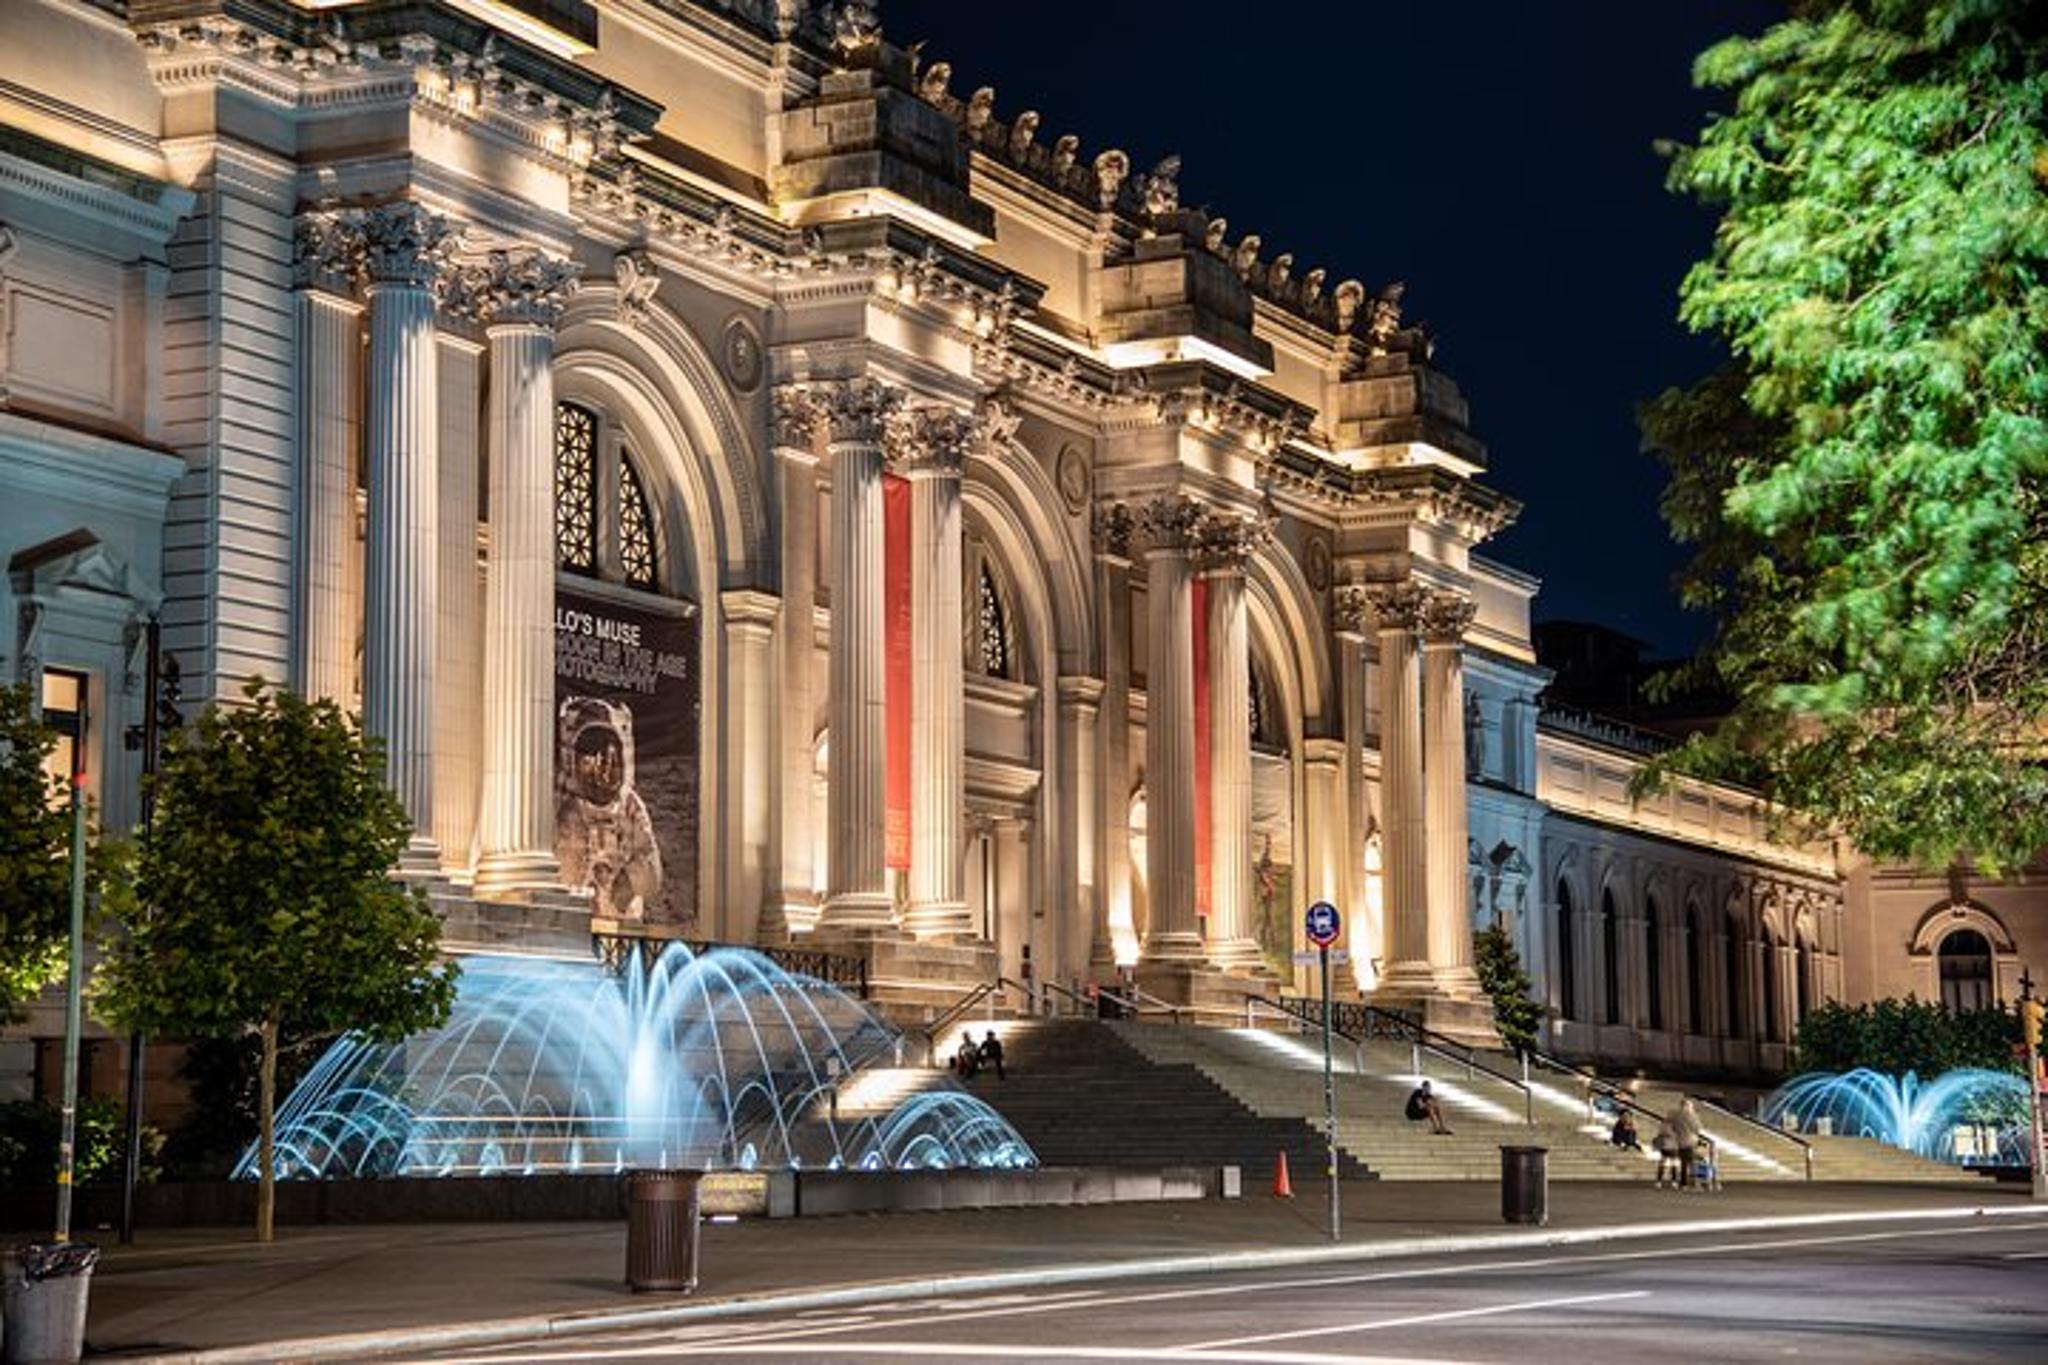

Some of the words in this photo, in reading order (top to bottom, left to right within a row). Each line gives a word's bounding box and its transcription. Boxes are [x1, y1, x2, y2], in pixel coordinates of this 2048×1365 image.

[555, 607, 592, 635] LO'S
[596, 616, 641, 646] MUSE
[623, 644, 654, 672] THE
[656, 652, 687, 680] AGE
